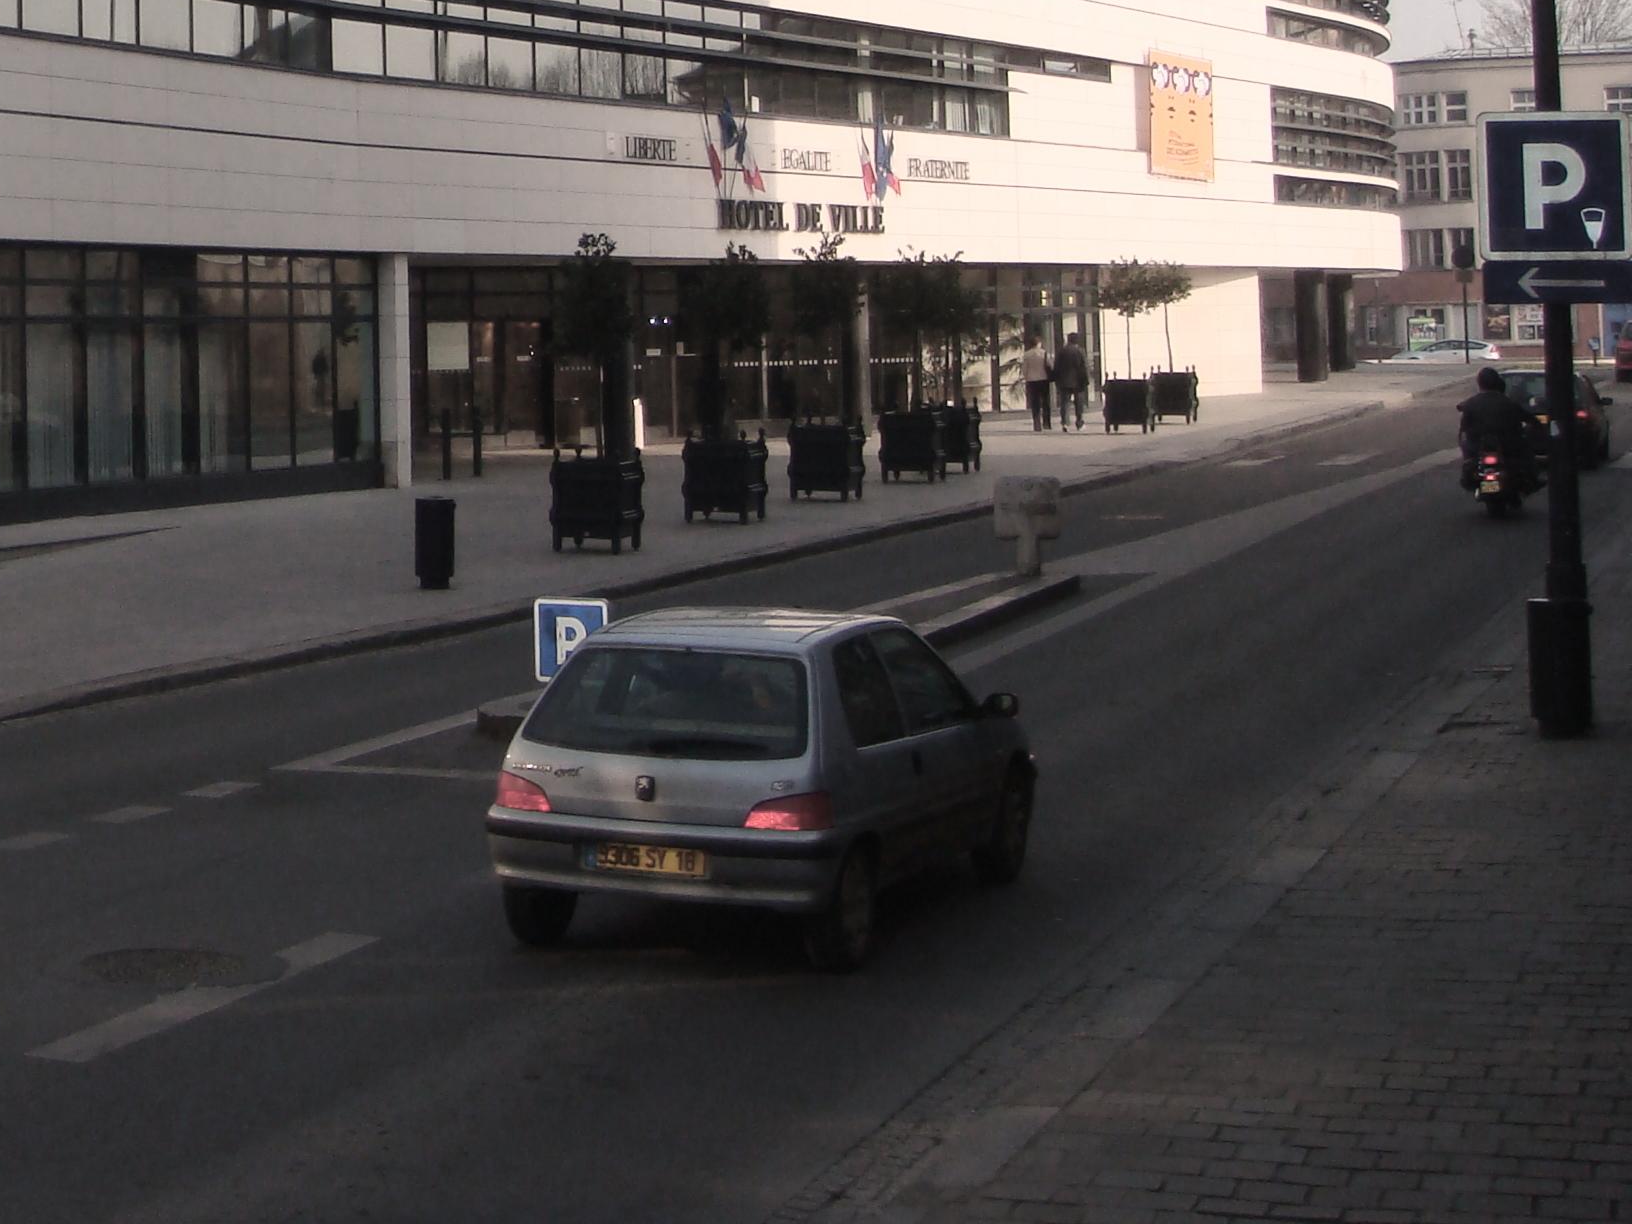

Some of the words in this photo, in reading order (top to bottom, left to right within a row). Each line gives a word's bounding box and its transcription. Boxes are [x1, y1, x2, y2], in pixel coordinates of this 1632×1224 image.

[1522, 142, 1586, 230] P
[718, 198, 789, 232] HOTEL
[794, 202, 823, 232] DE
[829, 205, 886, 235] VILLE
[554, 615, 588, 666] P
